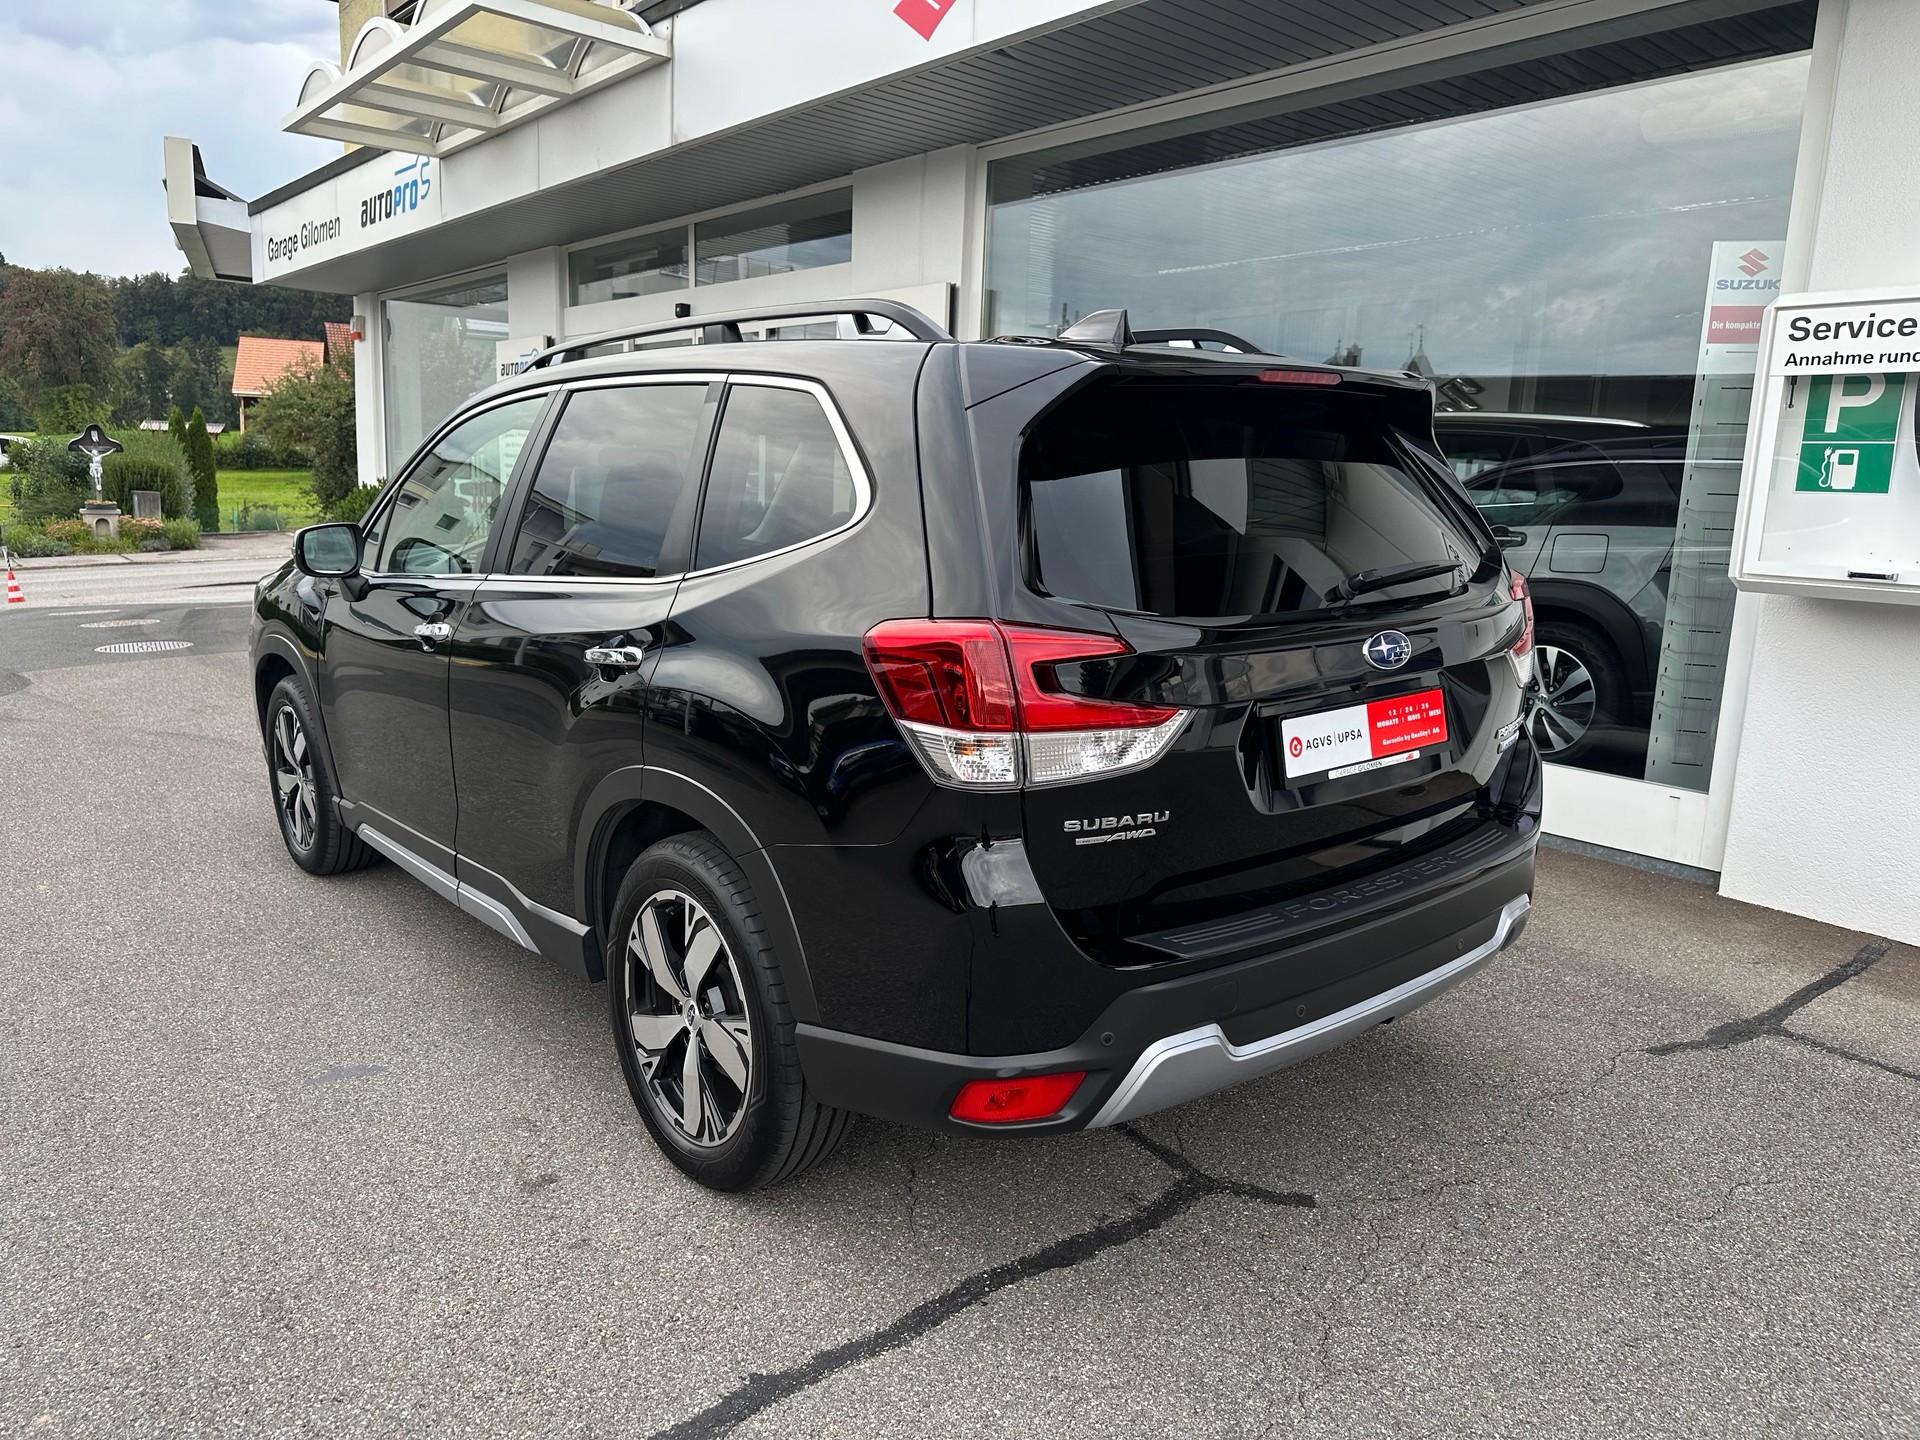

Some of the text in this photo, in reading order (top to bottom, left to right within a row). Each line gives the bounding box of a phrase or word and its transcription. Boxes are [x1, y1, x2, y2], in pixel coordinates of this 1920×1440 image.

[268, 216, 341, 262] Garage Gilomen
[1716, 279, 1781, 291] SUZUK
[1711, 320, 1761, 332] Die kompakte
[1788, 313, 1918, 342] Service
[1784, 351, 1874, 367] Annahme
[1824, 373, 1886, 433] P
[1404, 705, 1413, 713] 24
[1421, 702, 1429, 710] 36
[1432, 727, 1441, 735] AG
[1306, 728, 1363, 751] AGVS UPSA
[1357, 760, 1383, 772] GILOMEN
[1063, 810, 1170, 832] SUBARU
[1107, 828, 1157, 843] AWD
[1284, 856, 1459, 919] FORESTER
